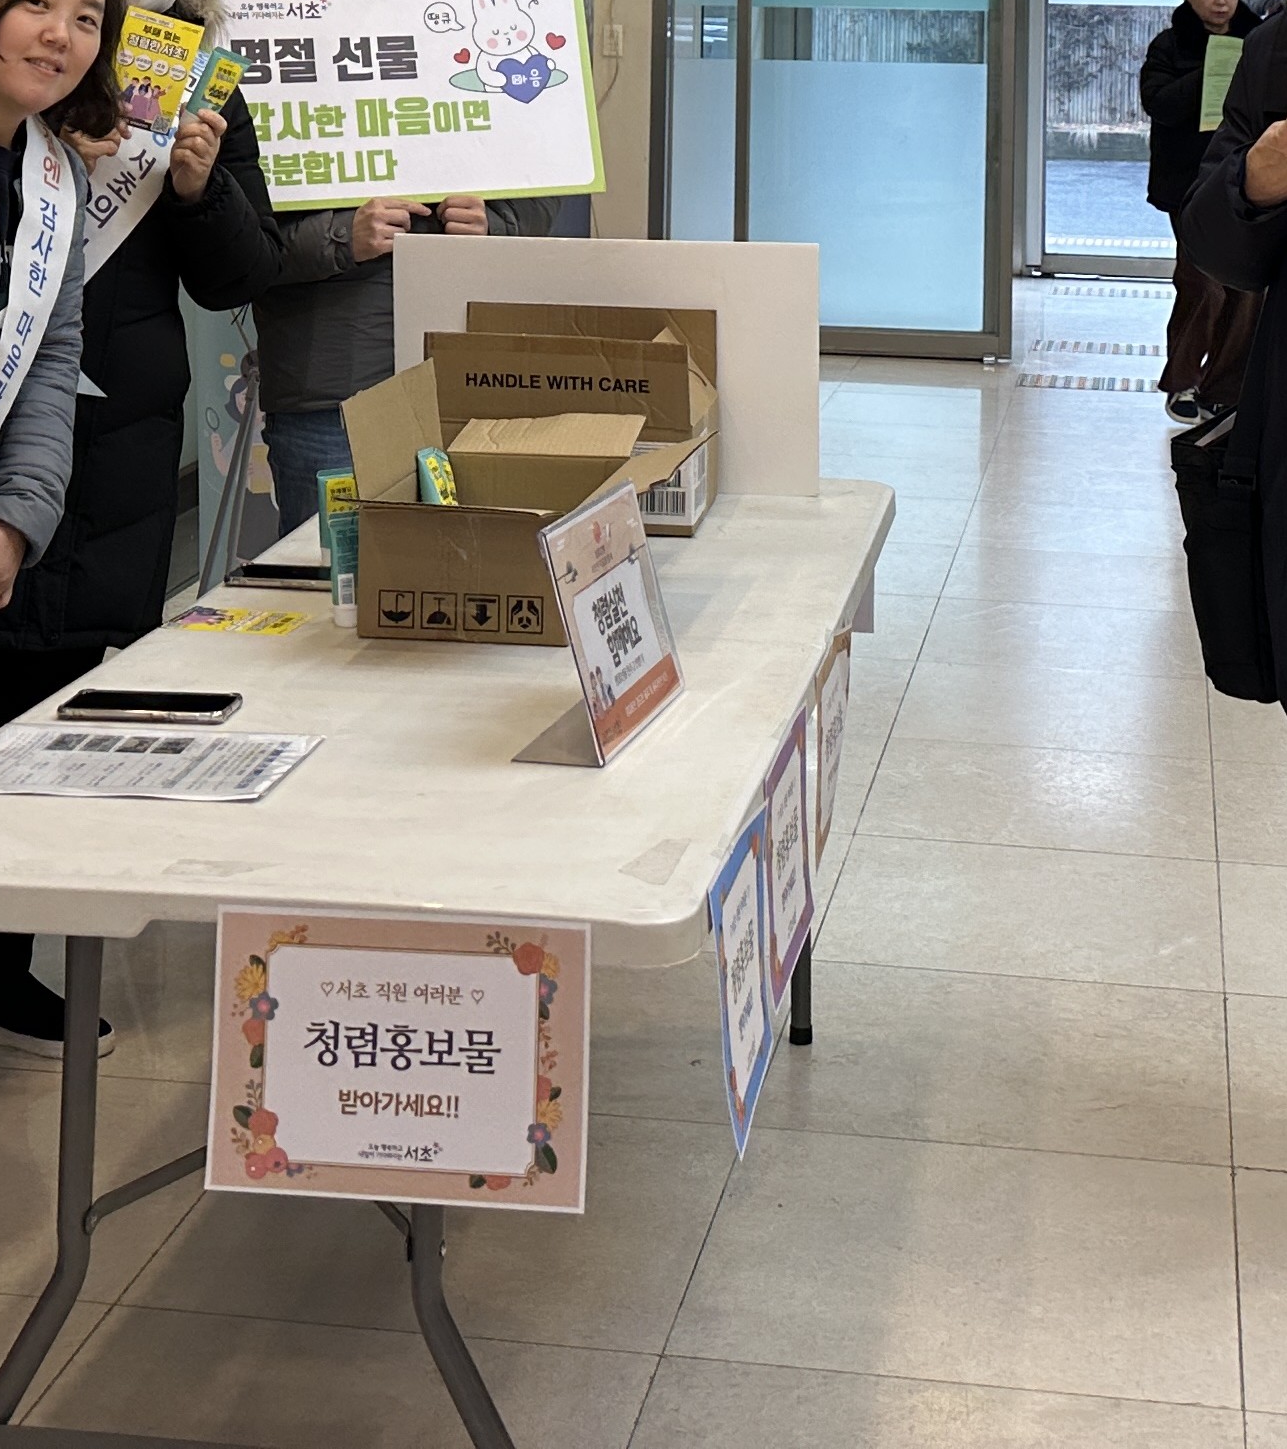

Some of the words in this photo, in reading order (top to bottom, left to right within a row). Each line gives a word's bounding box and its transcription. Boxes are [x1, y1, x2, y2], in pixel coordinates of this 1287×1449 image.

[286, 0, 322, 20] 서초
[230, 37, 317, 85] 명절
[332, 35, 418, 82] 선물
[355, 96, 492, 138] 마음이면
[28, 197, 58, 297] 감사한
[465, 372, 542, 390] HANDLE
[547, 374, 594, 392] WITH
[598, 376, 650, 394] CARE
[335, 980, 370, 1000] 서초
[375, 982, 407, 1002] 직원
[413, 985, 464, 1005] 여러분
[303, 1019, 502, 1075] 청렴홍보물
[338, 1088, 460, 1119] 받아가세요!!
[404, 1145, 433, 1162] 서초
